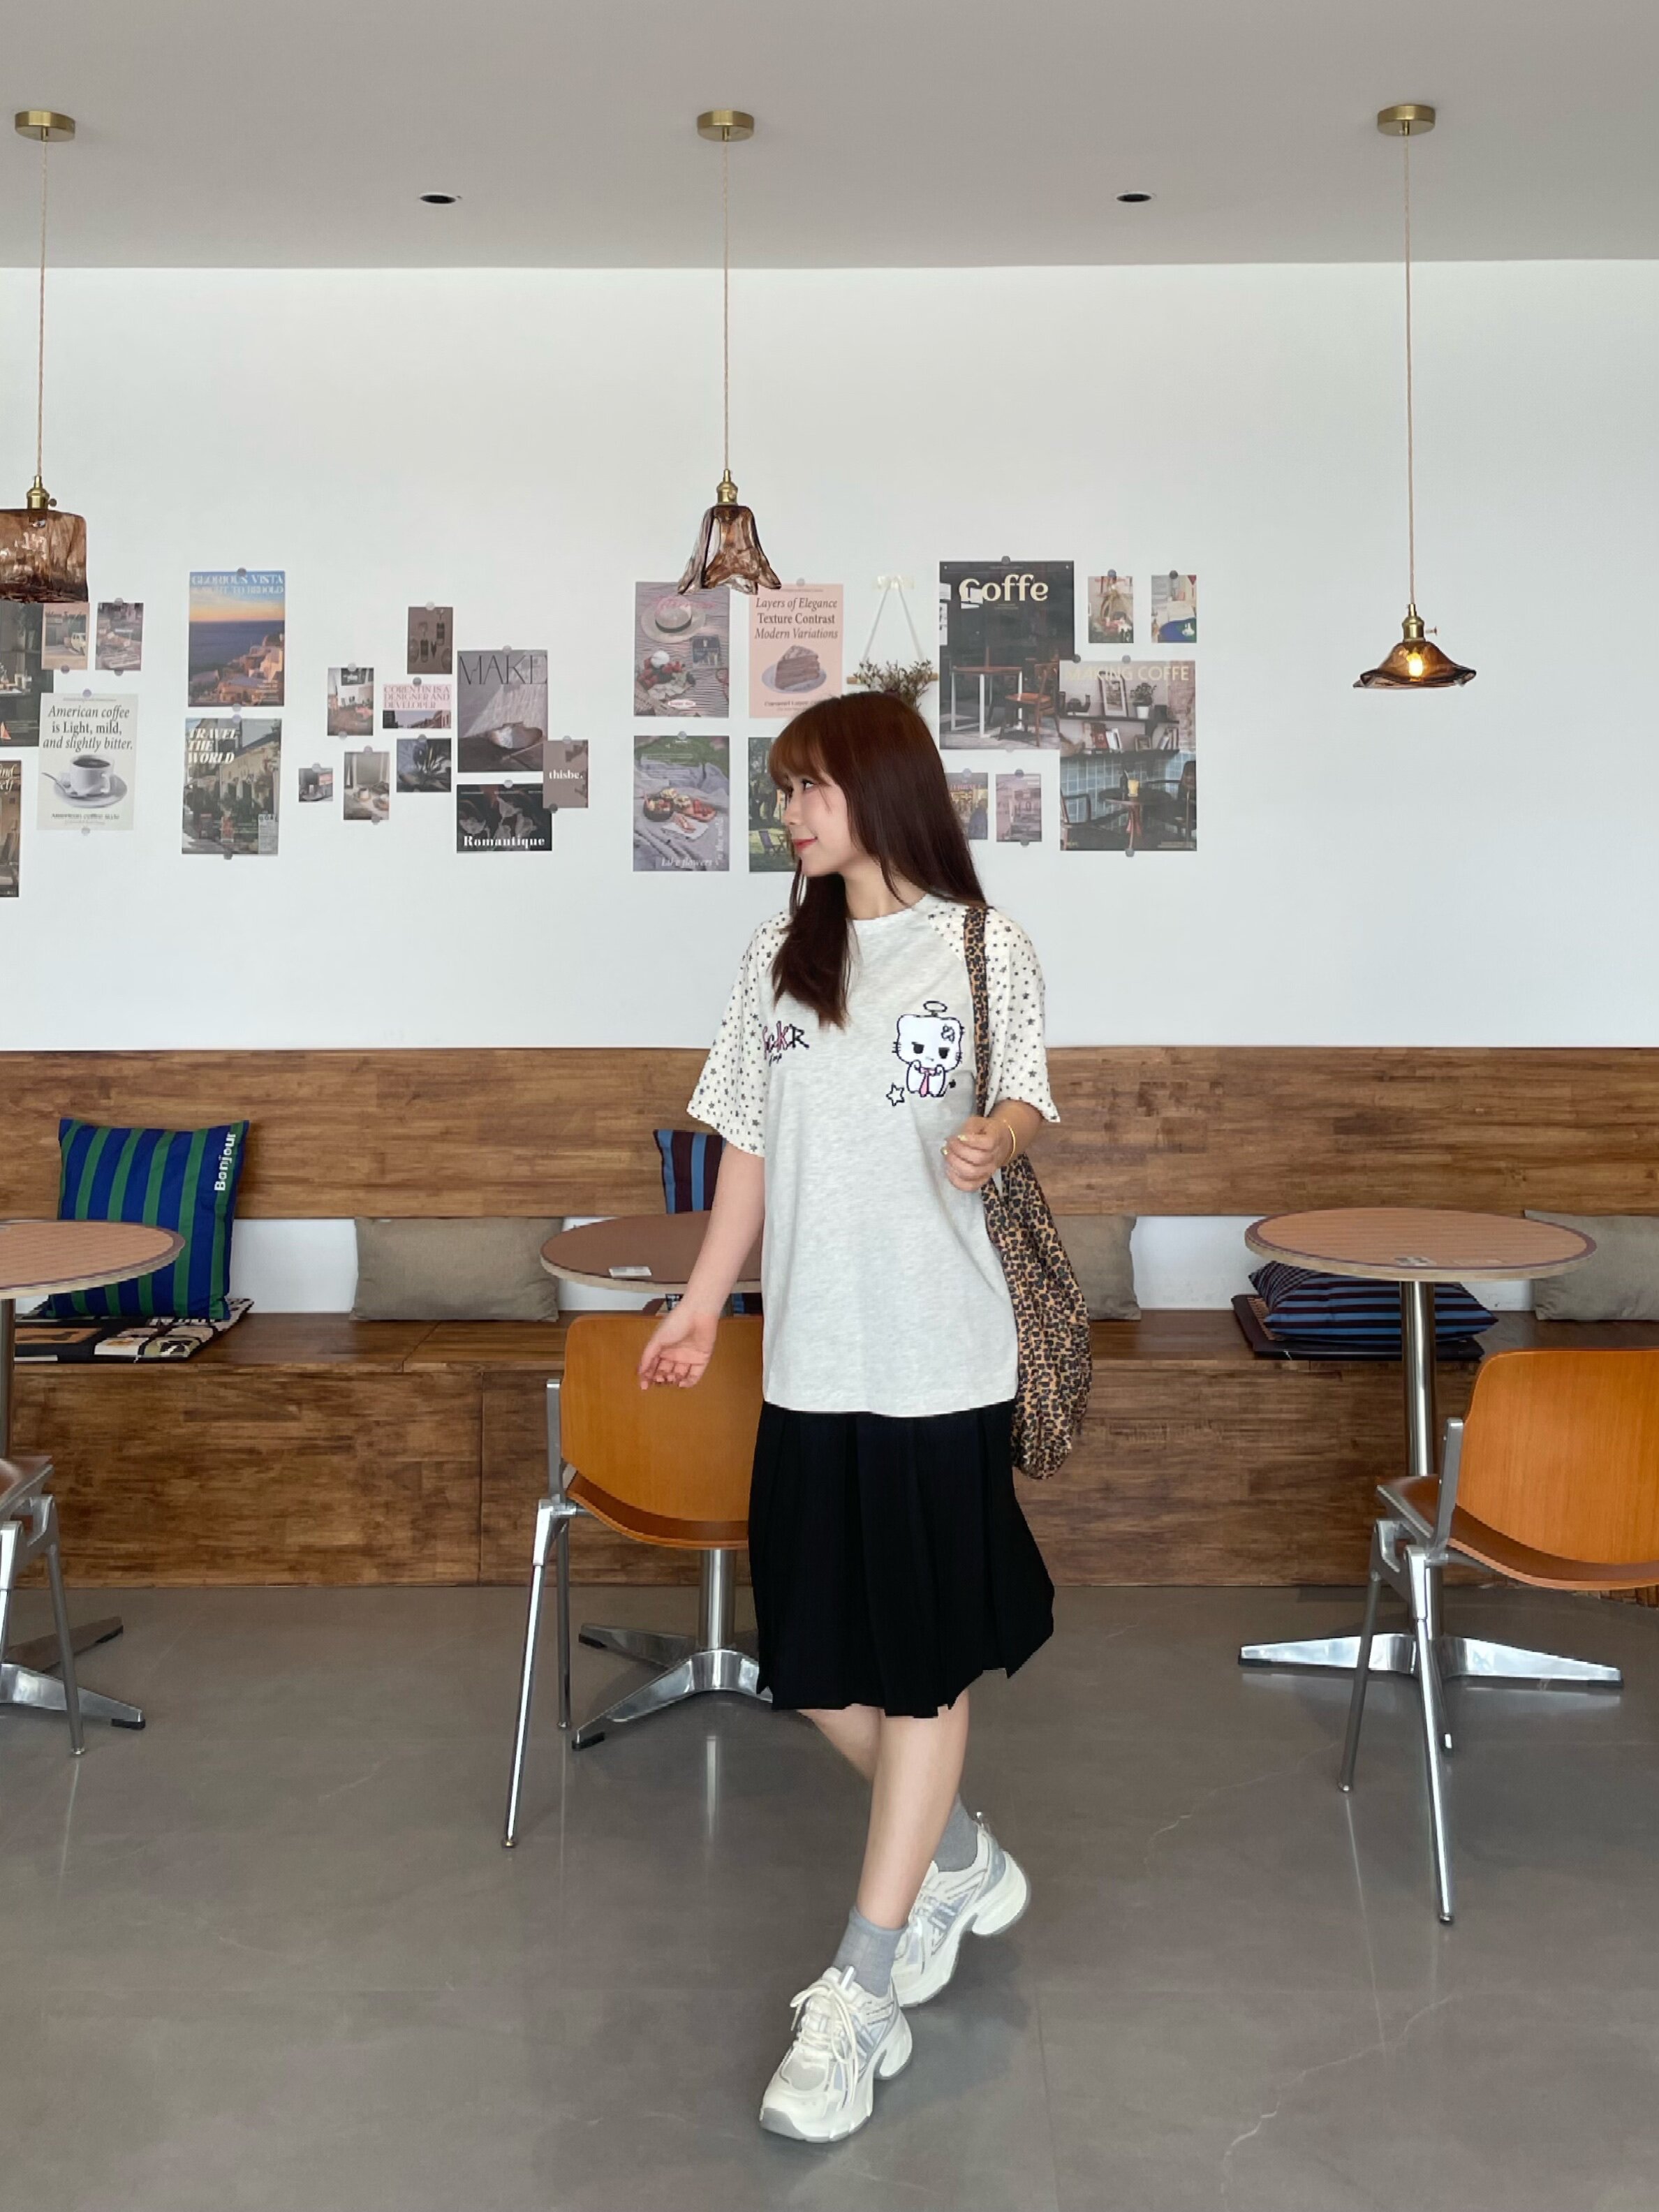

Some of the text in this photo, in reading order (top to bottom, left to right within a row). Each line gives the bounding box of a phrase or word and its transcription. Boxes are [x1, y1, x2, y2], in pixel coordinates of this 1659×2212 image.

[251, 575, 283, 584] VISTA
[755, 597, 838, 612] Layers of Elegance
[757, 612, 835, 624] Texture Contrast
[754, 627, 839, 639] Modern Variations
[1137, 665, 1189, 681] COFFE
[47, 705, 130, 721] American coffee
[52, 720, 122, 739] is Light, mild,
[189, 728, 237, 739] TRAVEL
[43, 735, 133, 753] and slightly bitter.
[188, 740, 214, 751] THE
[188, 752, 235, 764] WORLD
[464, 835, 545, 849] Romantique
[214, 1132, 236, 1191] Bonjour
